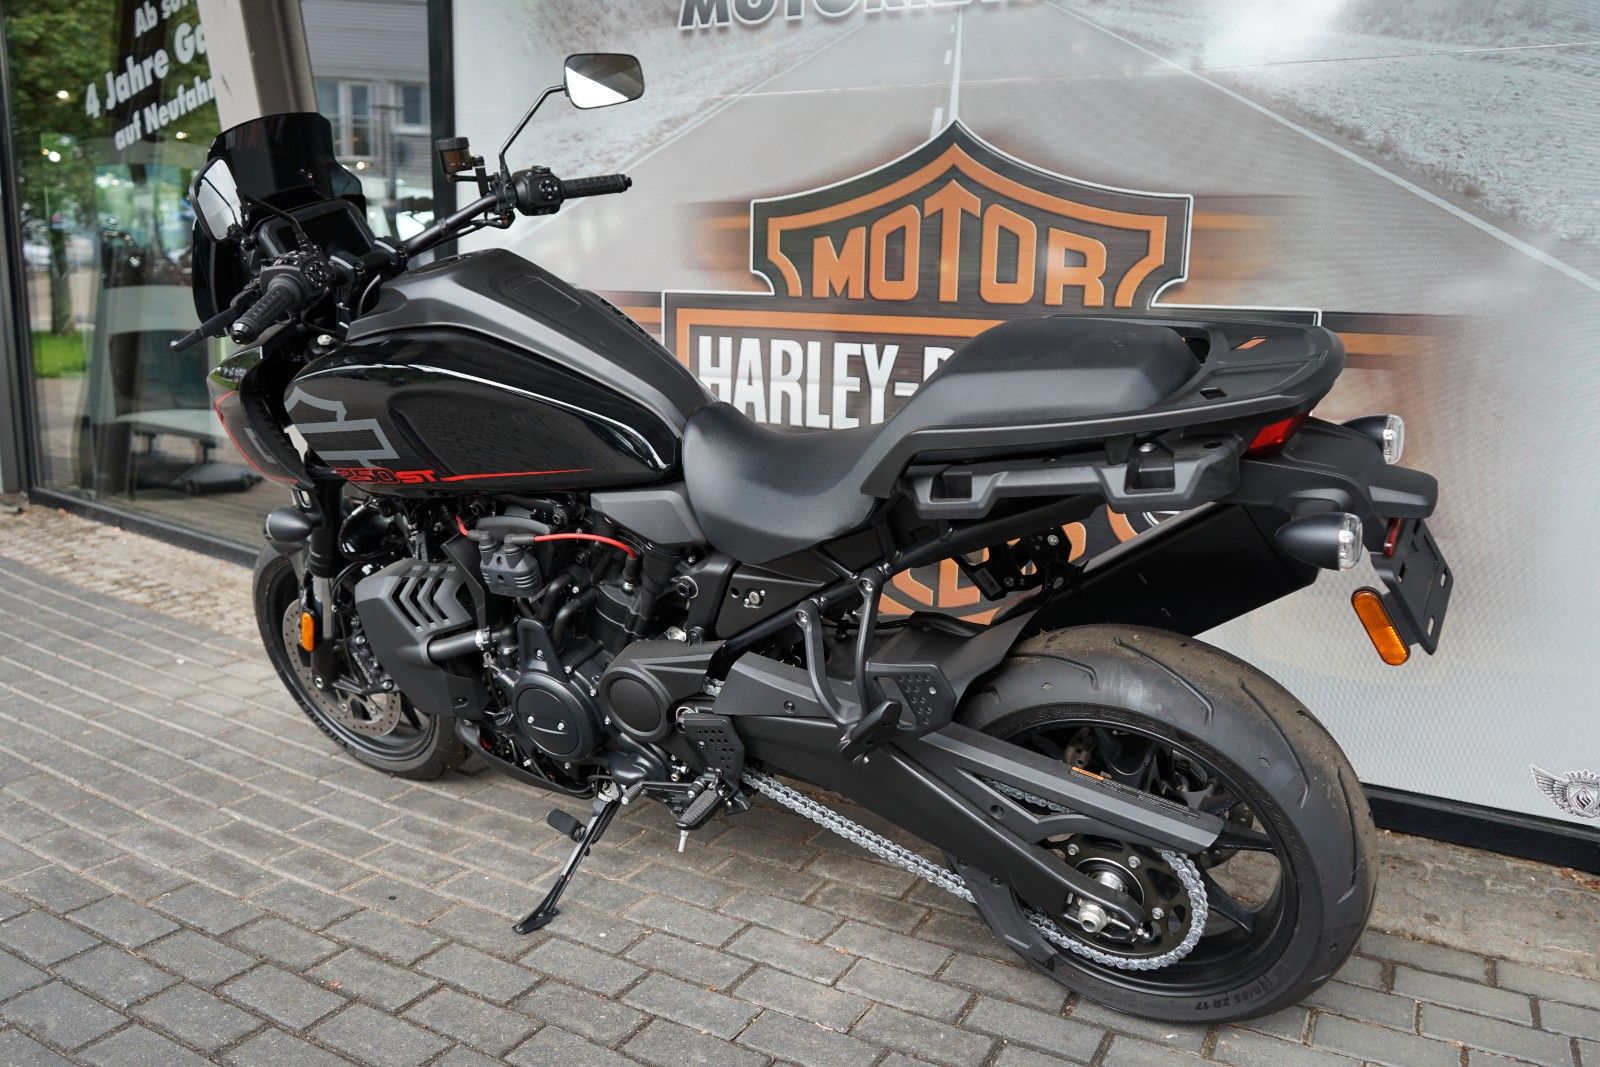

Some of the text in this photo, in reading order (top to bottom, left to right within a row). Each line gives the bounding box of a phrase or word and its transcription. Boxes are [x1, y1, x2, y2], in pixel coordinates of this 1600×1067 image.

[135, 0, 158, 37] Ab
[85, 82, 100, 119] 4
[105, 48, 169, 111] Jahre
[114, 110, 142, 150] auf
[812, 178, 1107, 307] MOTOR
